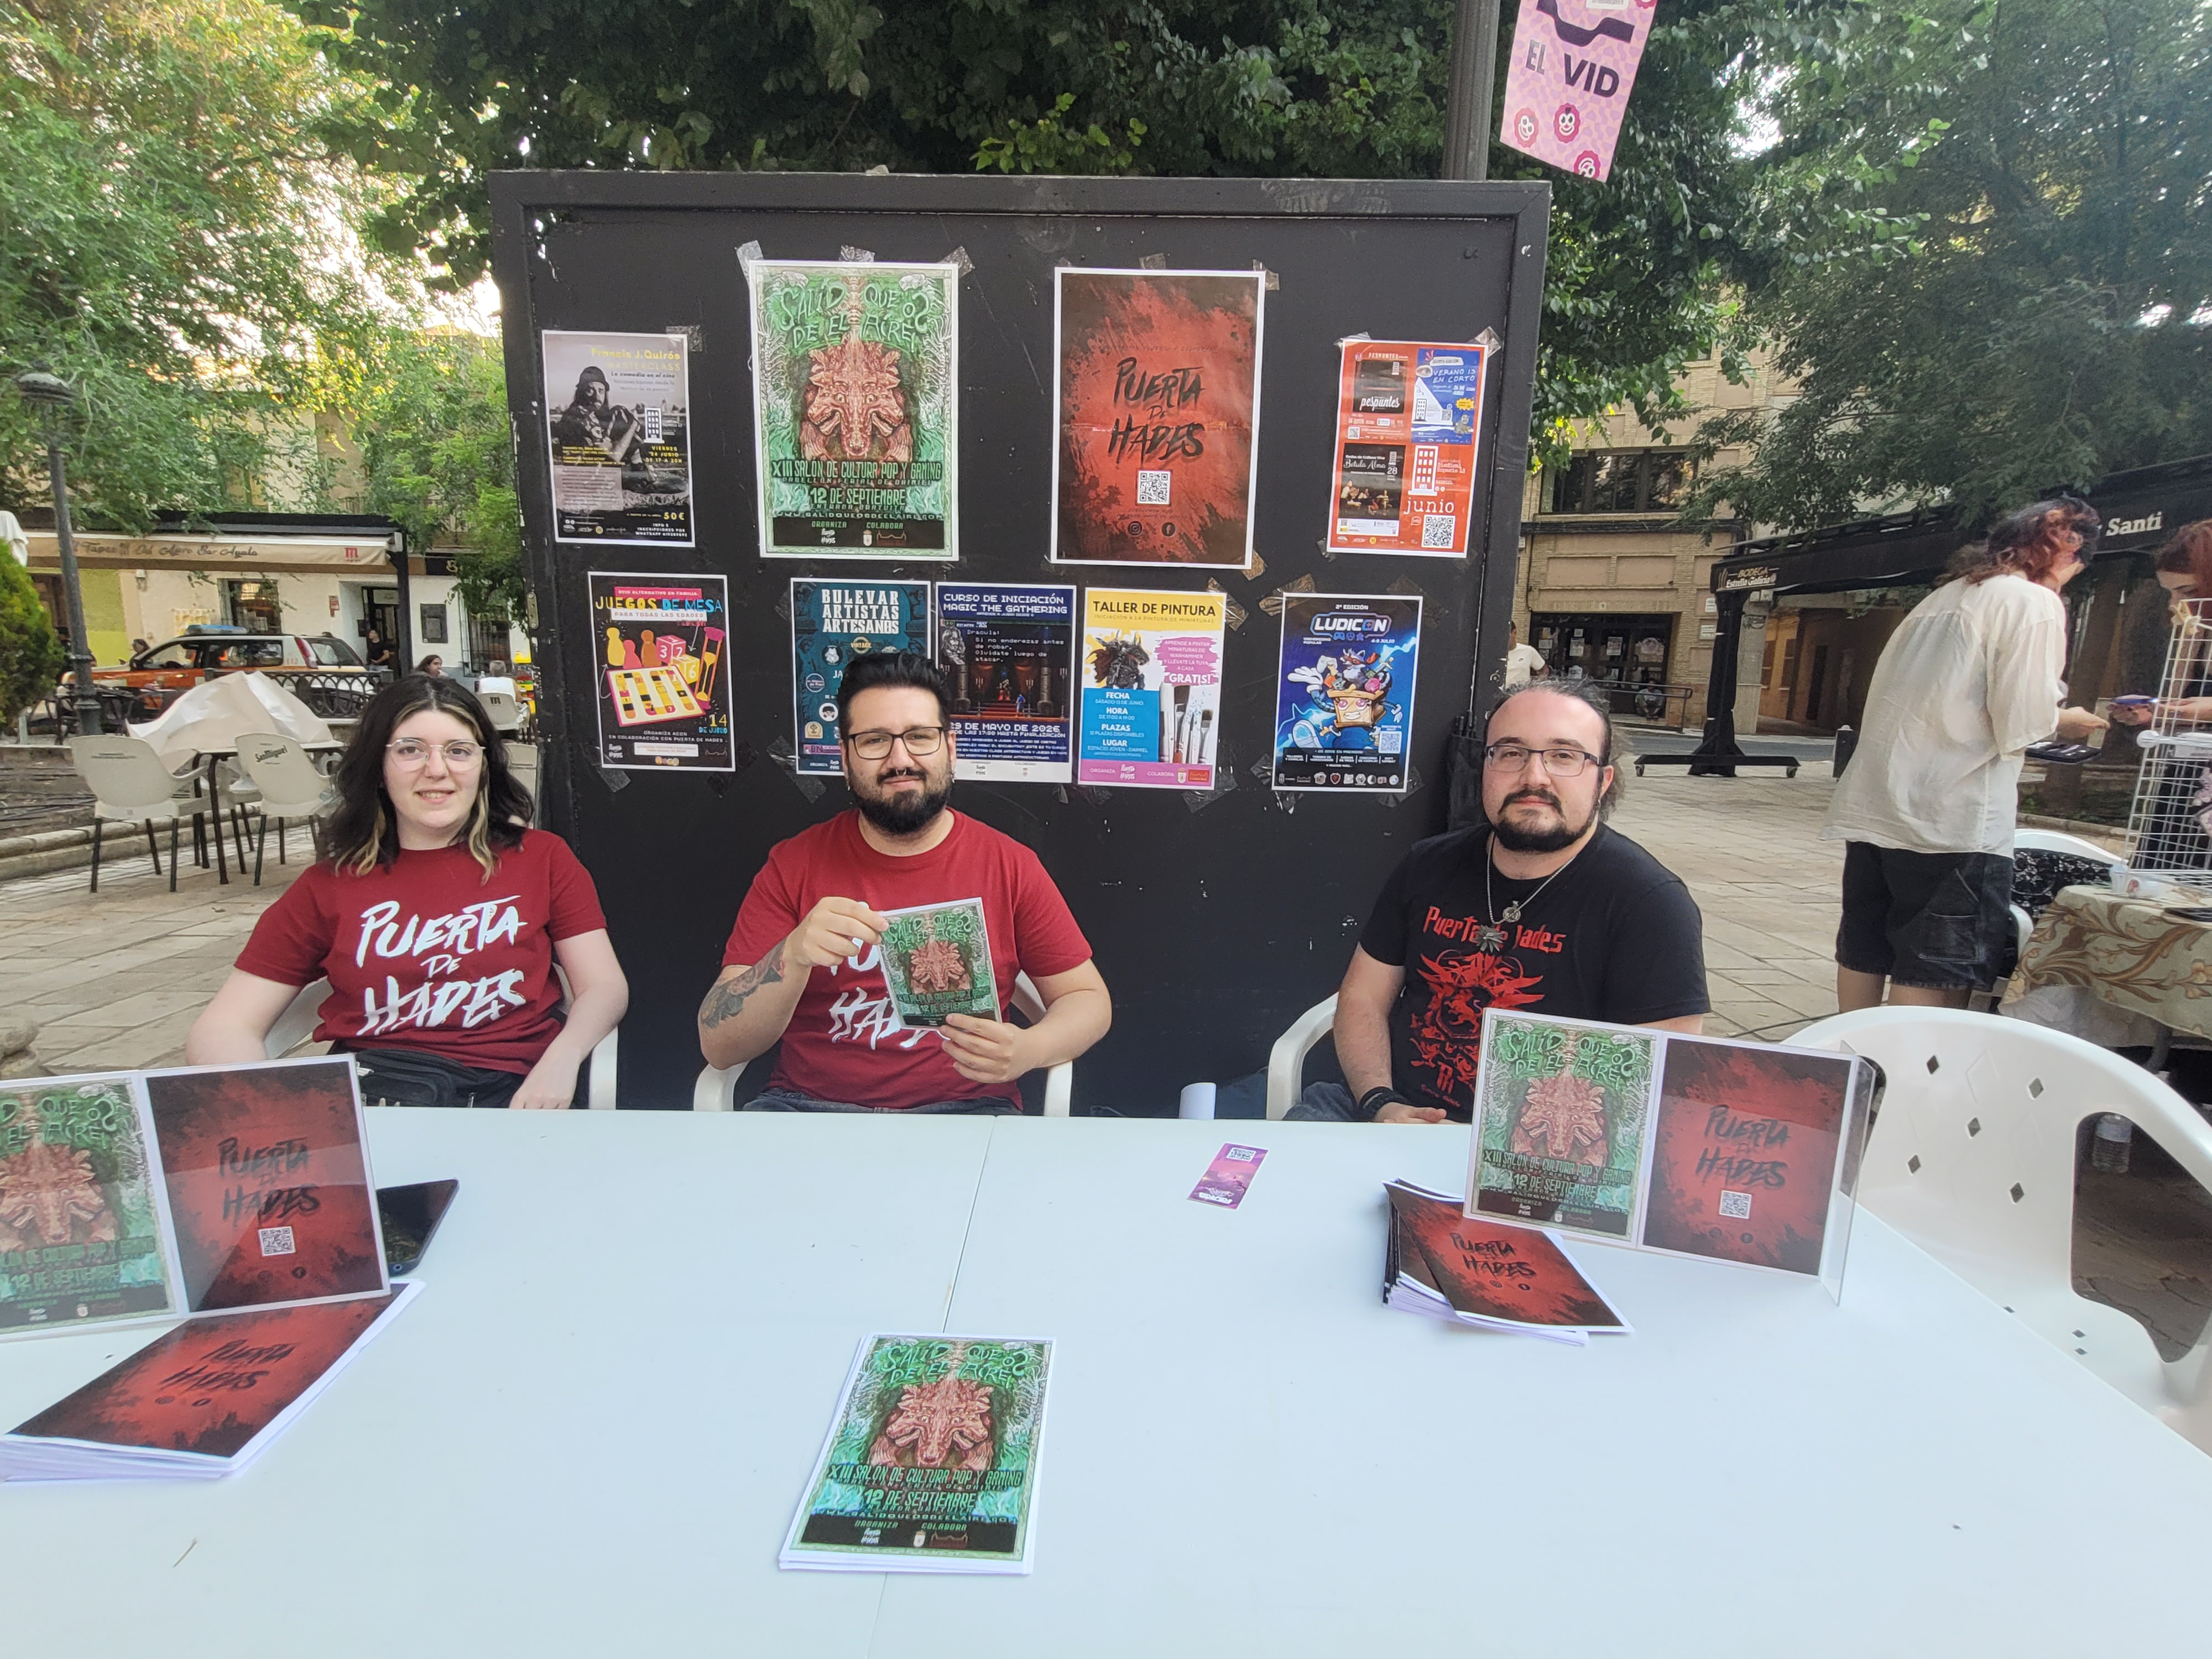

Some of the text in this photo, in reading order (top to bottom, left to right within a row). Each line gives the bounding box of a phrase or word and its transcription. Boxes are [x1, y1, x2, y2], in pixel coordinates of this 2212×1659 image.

[1525, 39, 1620, 98] EL VID
[864, 283, 902, 308] QUE
[793, 312, 851, 349] DE EL
[591, 348, 631, 358] Francis
[1113, 356, 1206, 408] PUERTA
[1147, 405, 1168, 420] DE
[1359, 396, 1401, 411] pespuntes
[1107, 414, 1207, 464] HADES
[773, 458, 941, 479] XIII SALÓN DE CULTURA POP Y GAMING
[810, 488, 906, 505] 12 DE SEPTIEMBRE
[1404, 498, 1454, 514] junio
[2105, 511, 2163, 536] Santi
[1725, 575, 1770, 588] Estrella Galicia
[1738, 567, 1768, 578] BODEGA
[595, 596, 723, 613] JUEGOS DE MESA
[821, 588, 899, 605] BULEVAR
[944, 594, 980, 602] CURSO
[1001, 593, 1064, 604] INICIACIÓN
[822, 604, 899, 620] ARTISTAS
[943, 603, 977, 612] MAGIC
[1005, 606, 1068, 614] GATHERING
[1093, 601, 1215, 616] TALLER DE PINTURA
[822, 618, 899, 634] ARTESANOS
[1314, 618, 1387, 632] LUDICON
[1169, 673, 1211, 684] GRATIS!
[709, 713, 727, 727] 14
[355, 894, 528, 968] PUERTA
[898, 941, 912, 951] DE
[420, 953, 463, 980] DE
[356, 968, 526, 1036] HADES
[1579, 1037, 1610, 1055] QUE
[1515, 1052, 1564, 1075] DE EL
[1704, 1104, 1792, 1147] PUERTA
[218, 1136, 312, 1176] PUERTA
[1484, 1150, 1631, 1184] XIII DE CULTURA POP GAMING
[1695, 1147, 1788, 1188] HADES
[1514, 1173, 1598, 1198] 12 DE SEPTIEMBRE
[223, 1183, 321, 1228] HADES
[1449, 1233, 1516, 1256] PUERTA
[1462, 1254, 1537, 1277] HADES
[966, 1345, 999, 1363] QUE
[890, 1363, 948, 1383] DE EL
[828, 1463, 1022, 1488] XIII SALÓN DE CULTURA POP GAMING
[863, 1489, 977, 1510] 12 DE SEPTIEMBRE
[854, 1521, 968, 1531] ORGANIZA COLABORA
